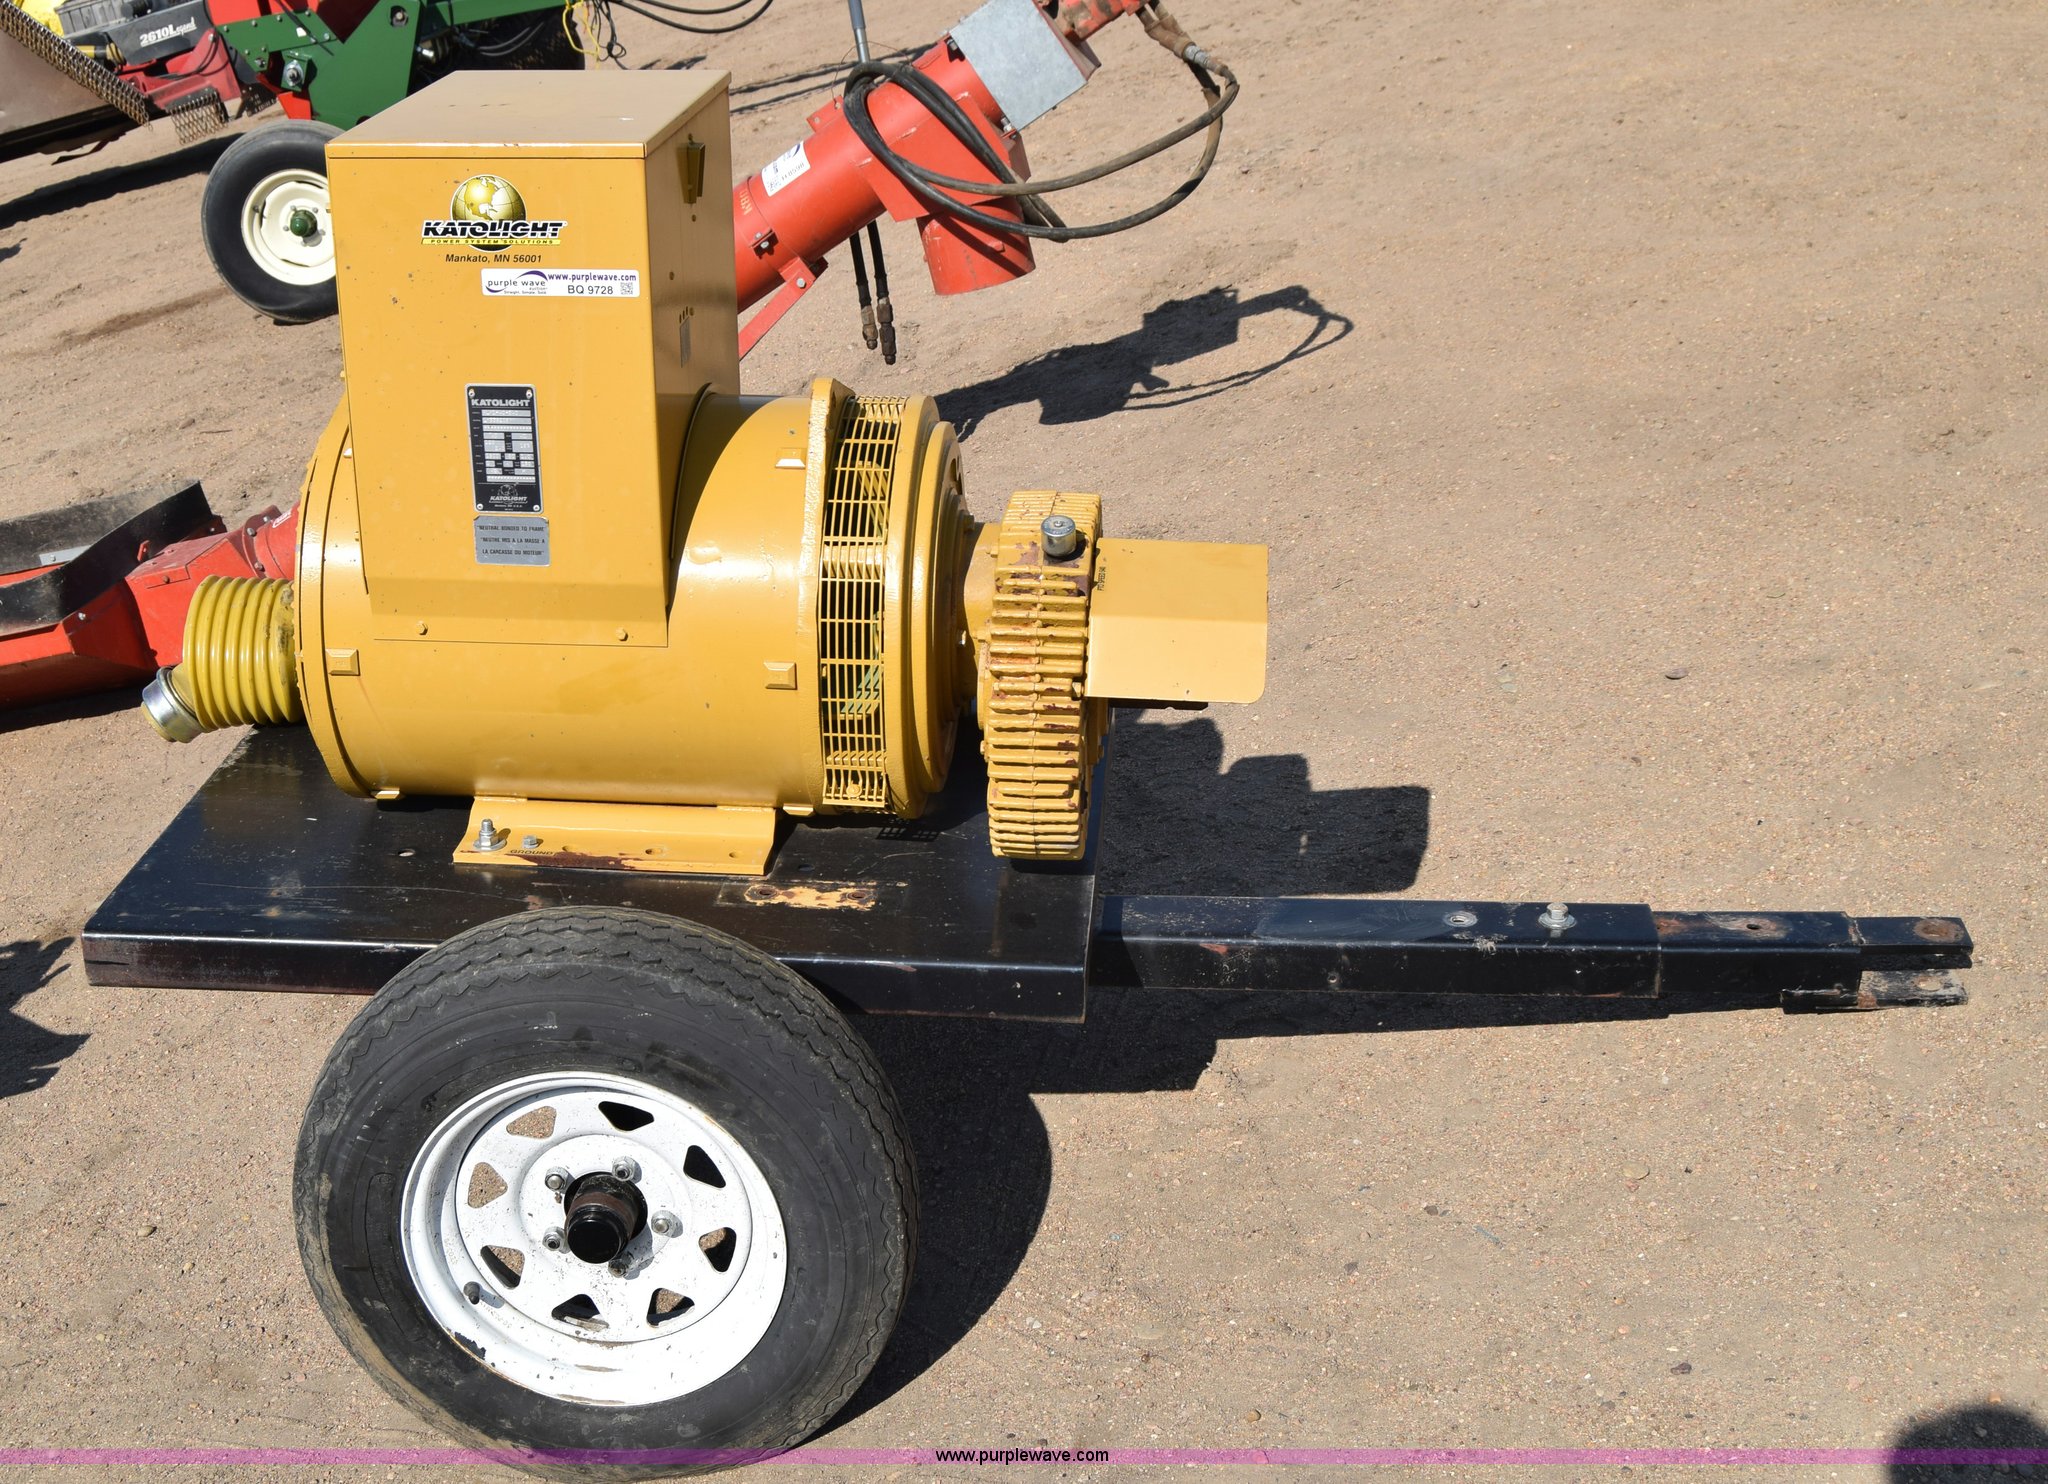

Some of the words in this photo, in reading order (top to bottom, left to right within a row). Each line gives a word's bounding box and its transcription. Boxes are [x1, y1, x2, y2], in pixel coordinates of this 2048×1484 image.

[422, 221, 564, 238] KATOLIGHT
[445, 254, 490, 263] Mankato,
[493, 254, 510, 262] MN
[513, 254, 542, 263] 56001
[548, 272, 637, 282] www.purplewave.com
[488, 279, 518, 287] purple
[567, 284, 584, 295] BQ
[588, 285, 614, 295] 9728
[471, 399, 530, 407] KATOLIGHT
